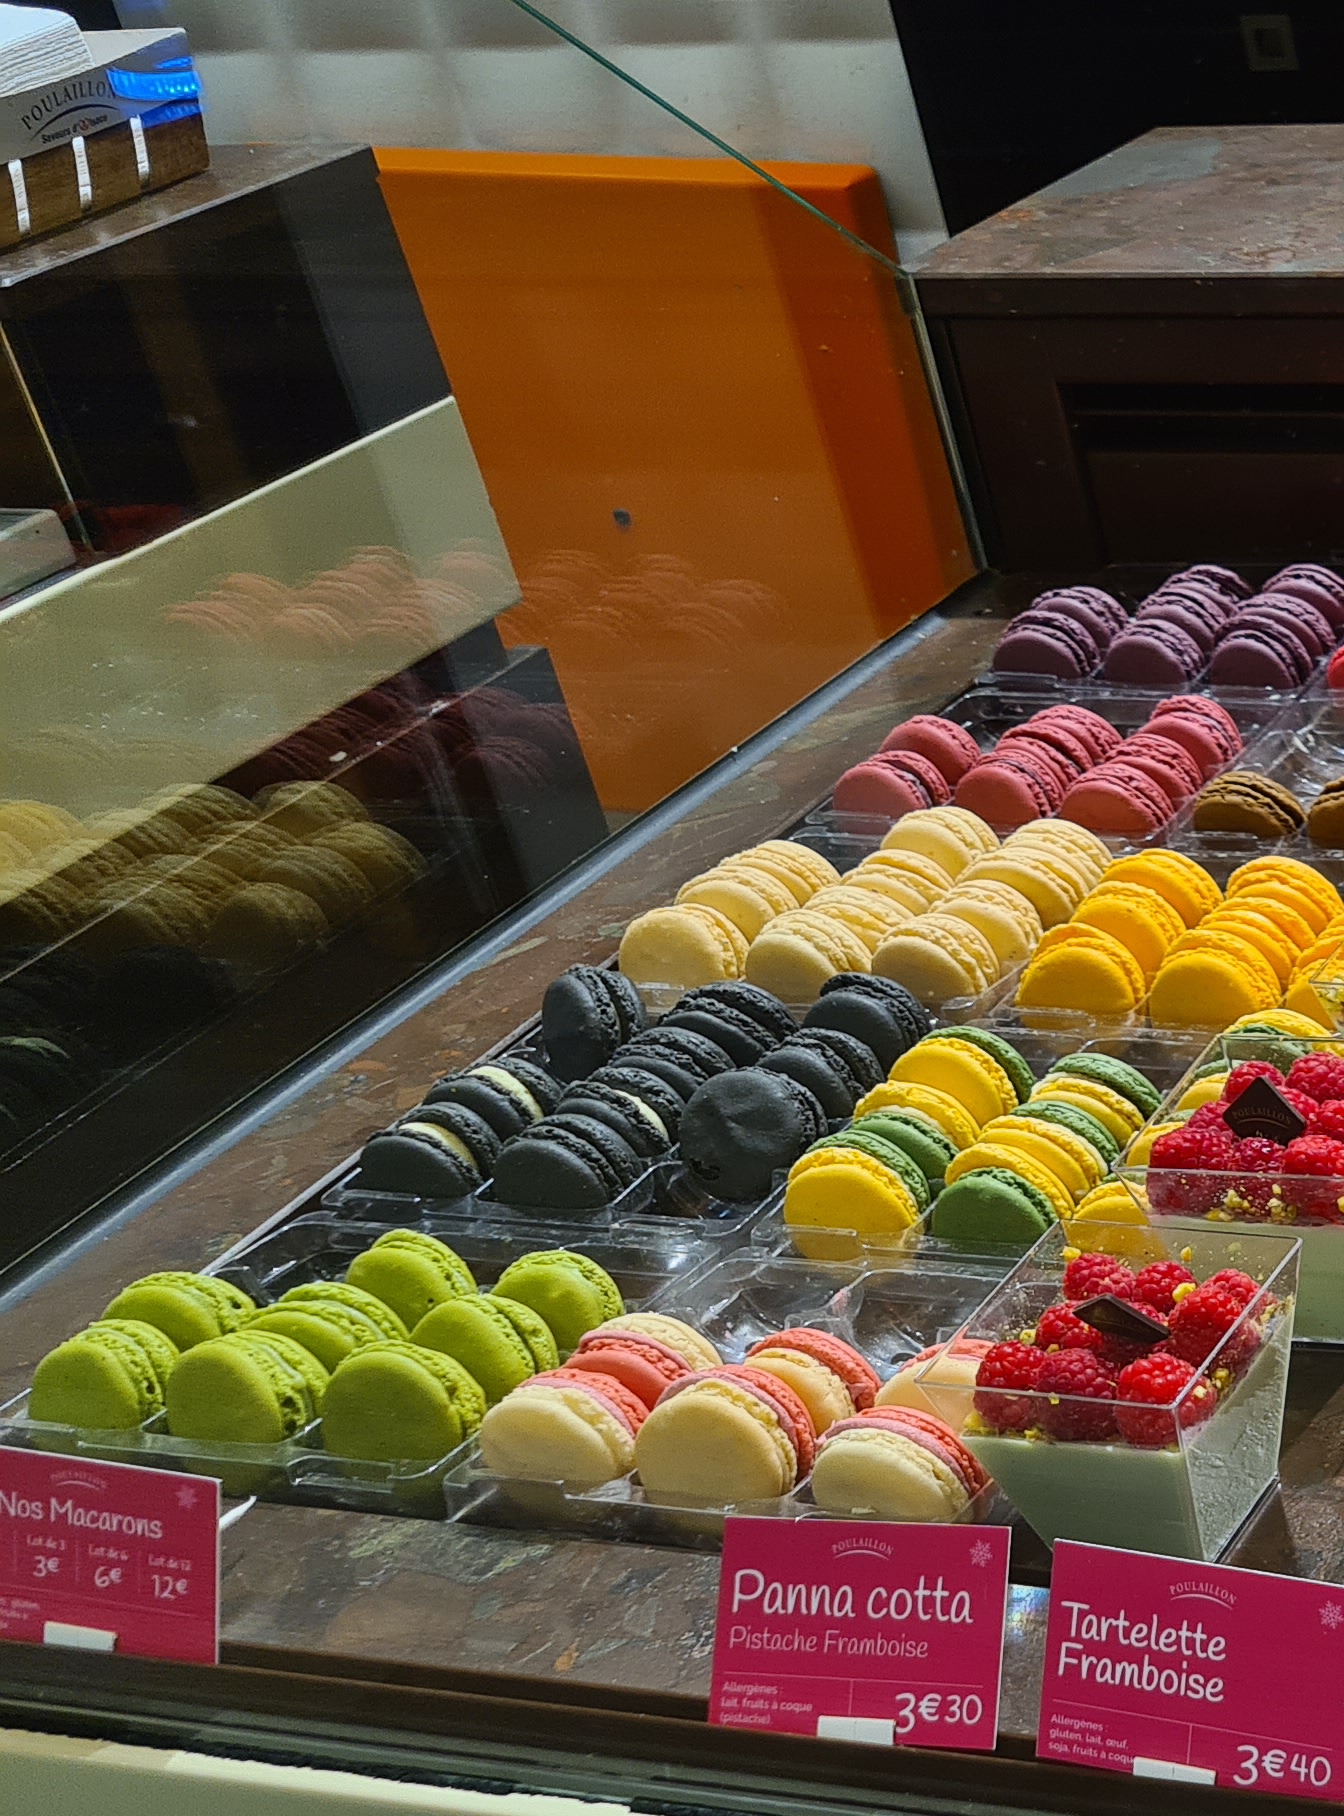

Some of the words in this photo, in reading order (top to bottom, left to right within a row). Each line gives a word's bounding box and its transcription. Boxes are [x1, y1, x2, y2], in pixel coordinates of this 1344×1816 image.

[0, 1490, 44, 1521] Nos
[50, 1496, 163, 1539] Macarons
[831, 1538, 895, 1556] POULAILLON
[32, 1555, 61, 1578] 3€
[94, 1566, 123, 1588] 6€
[152, 1575, 189, 1600] 12€
[731, 1568, 856, 1618] Panna
[866, 1575, 974, 1625] cotta
[1169, 1581, 1237, 1605] POULAILLON
[728, 1625, 817, 1654] Pistache
[822, 1629, 929, 1658] Framboise
[1060, 1600, 1227, 1662] Tartelette
[1057, 1641, 1225, 1702] Framboise
[894, 1692, 983, 1734] 3€30
[1072, 1744, 1098, 1759] fruits
[1108, 1752, 1134, 1765] coqu
[1232, 1744, 1332, 1787] 3€40
